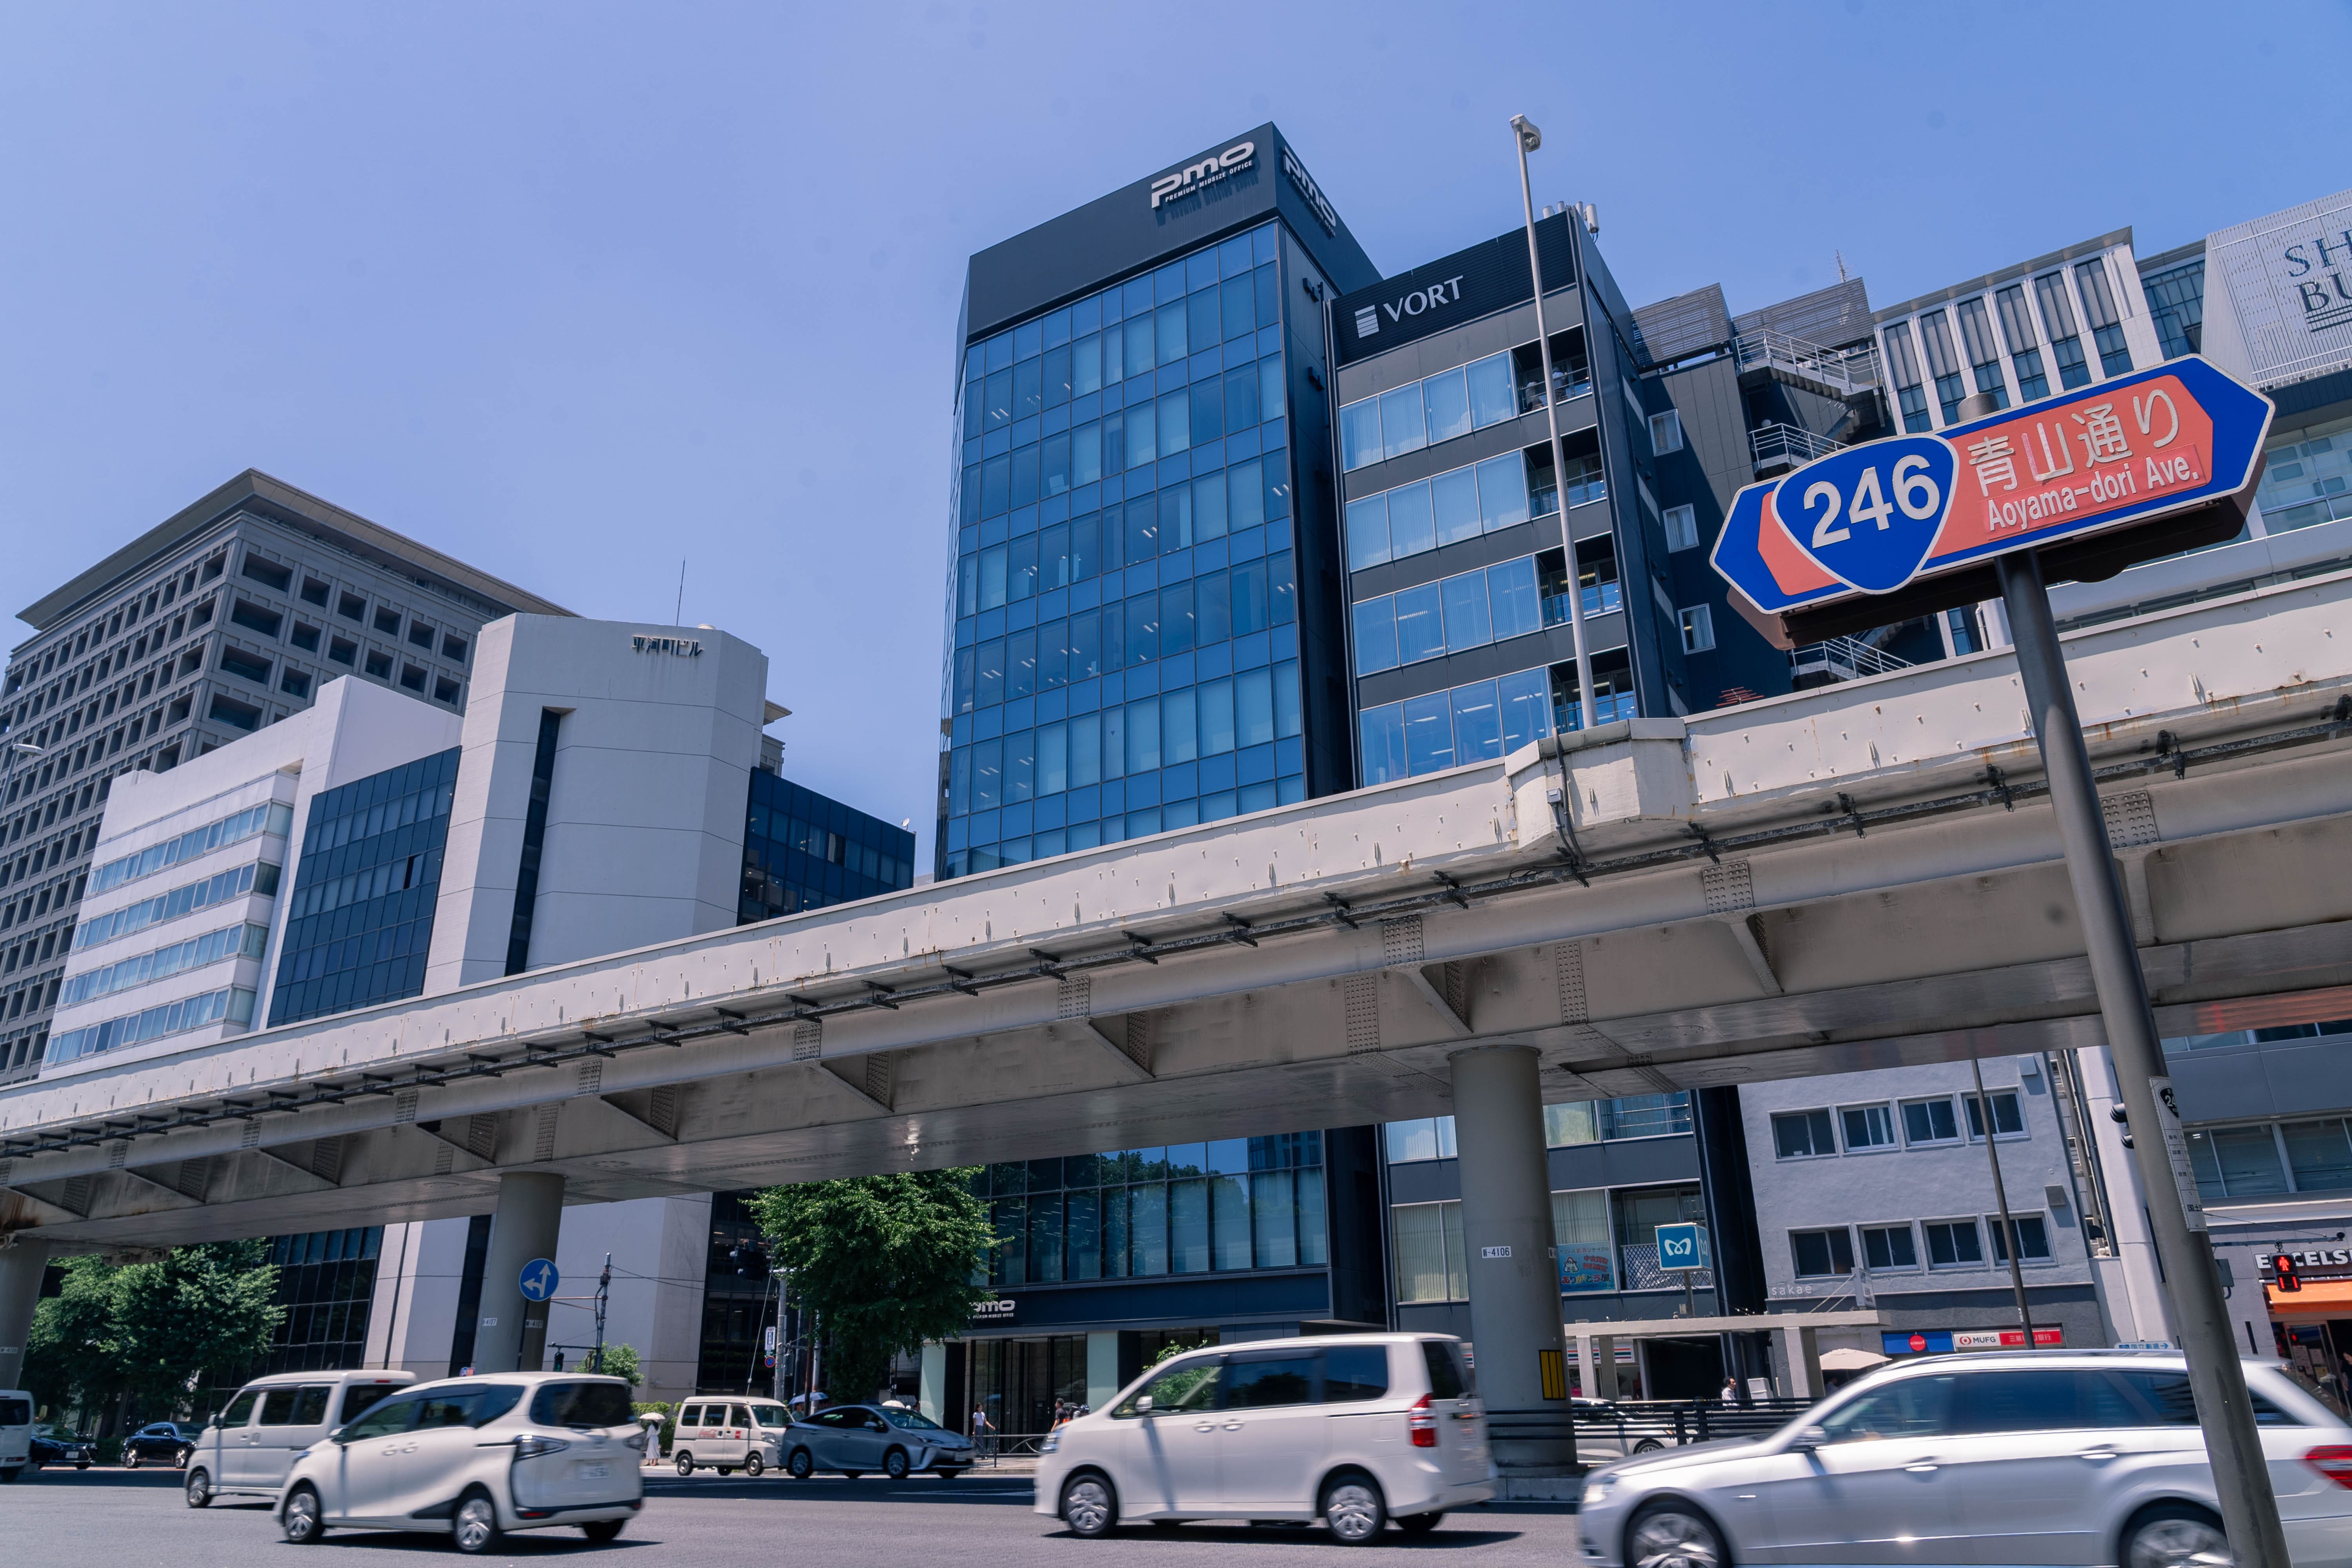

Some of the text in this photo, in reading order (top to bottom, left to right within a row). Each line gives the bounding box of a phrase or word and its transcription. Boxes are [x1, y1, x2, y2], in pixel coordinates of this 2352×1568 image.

[1165, 160, 1252, 202] PREMIUM MIDSIZE OFFICE
[1383, 275, 1463, 322] VORT
[1967, 389, 2179, 497] 青山通り
[1804, 455, 1940, 549] 246
[1988, 456, 2200, 530] Aoyama-dori Ave.
[632, 636, 704, 658] 平河町ビル
[1483, 1247, 1510, 1257] 新-4106
[2255, 1249, 2352, 1269] ECELS
[1771, 1284, 1813, 1295] sakae
[2009, 1334, 2051, 1342] 三菱J銀行
